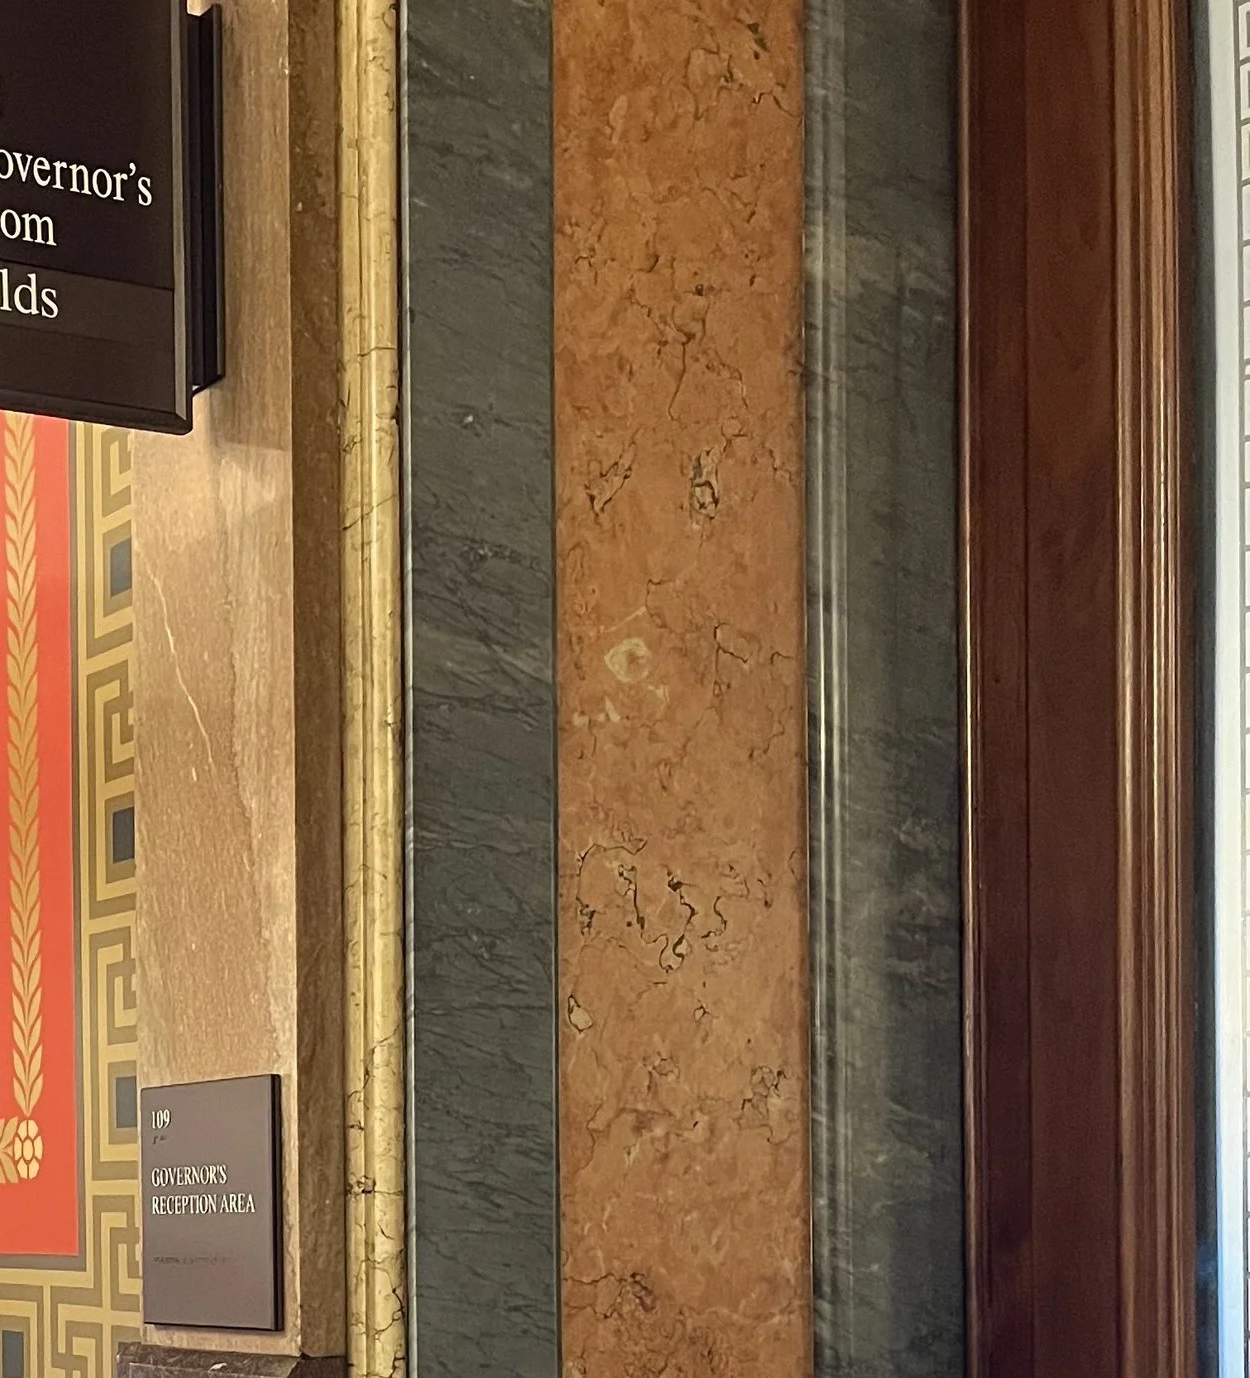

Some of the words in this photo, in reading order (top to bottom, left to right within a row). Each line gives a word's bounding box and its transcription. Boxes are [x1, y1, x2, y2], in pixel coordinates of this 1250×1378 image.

[151, 1108, 171, 1129] 109
[151, 1164, 228, 1187] GOVERNOR'S
[151, 1193, 217, 1215] RECEPTION
[220, 1193, 256, 1214] AREA
